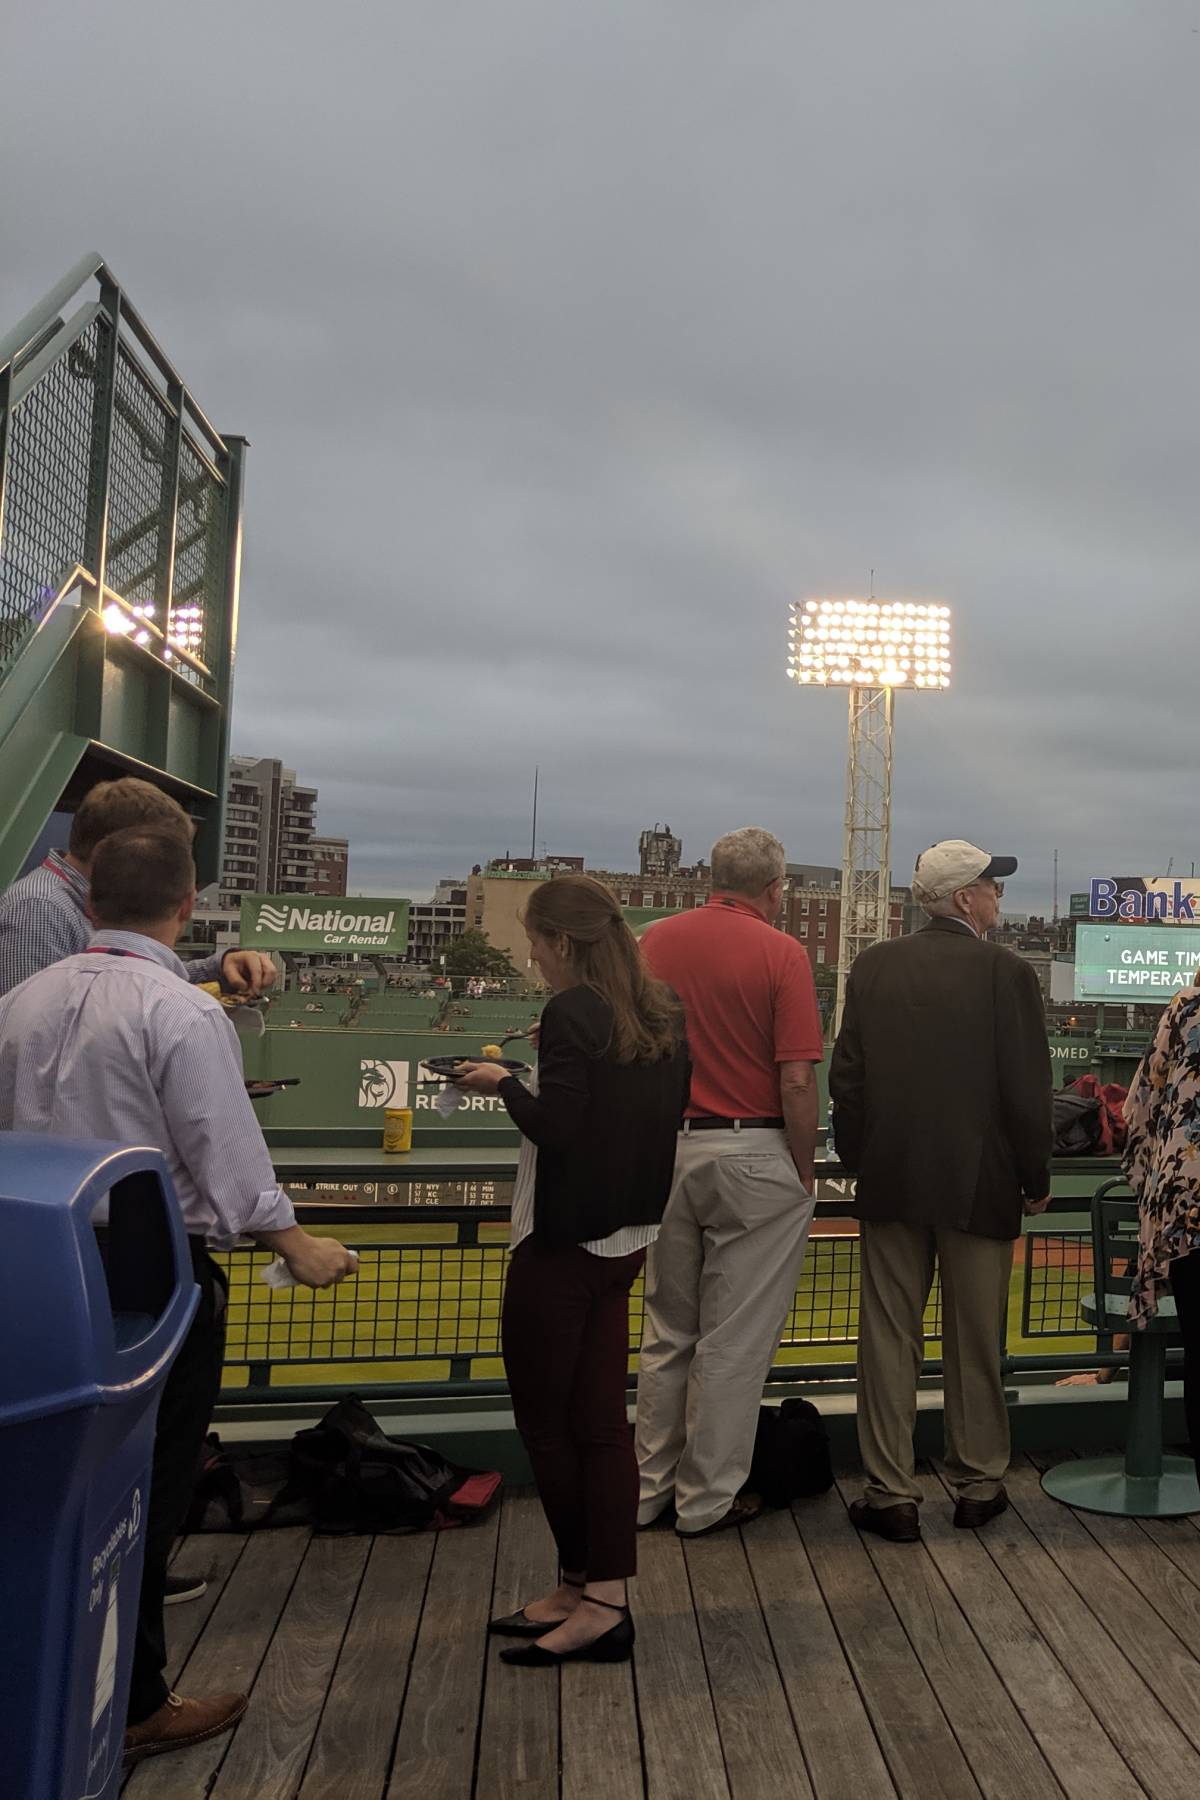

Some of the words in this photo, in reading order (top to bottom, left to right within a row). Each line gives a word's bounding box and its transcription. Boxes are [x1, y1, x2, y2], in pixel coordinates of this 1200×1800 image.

[1089, 877, 1196, 919] Bank
[324, 933, 346, 944] Car
[348, 935, 388, 945] Rental
[1121, 950, 1169, 966] GAME
[1107, 969, 1196, 986] TEMPERAT
[416, 1095, 507, 1112] REORTS
